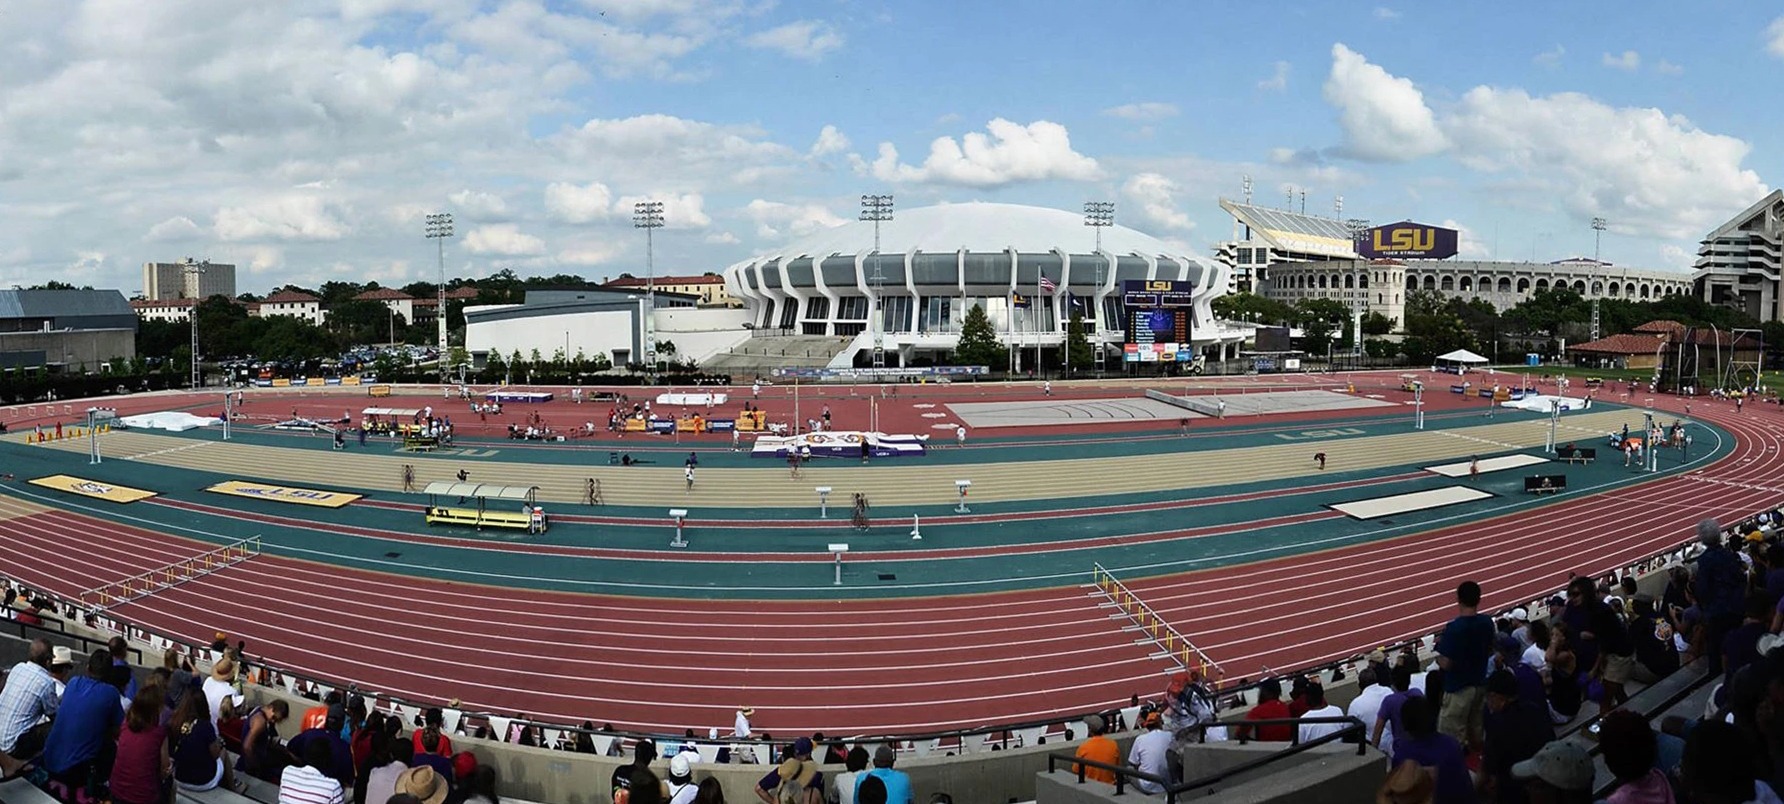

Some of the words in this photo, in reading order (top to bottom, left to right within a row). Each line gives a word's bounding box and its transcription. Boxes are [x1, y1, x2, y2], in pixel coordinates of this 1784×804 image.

[1373, 228, 1435, 251] LSU
[1145, 281, 1171, 291] LSU
[1274, 428, 1366, 440] LSU
[269, 488, 335, 500] LSU
[310, 714, 326, 729] 12
